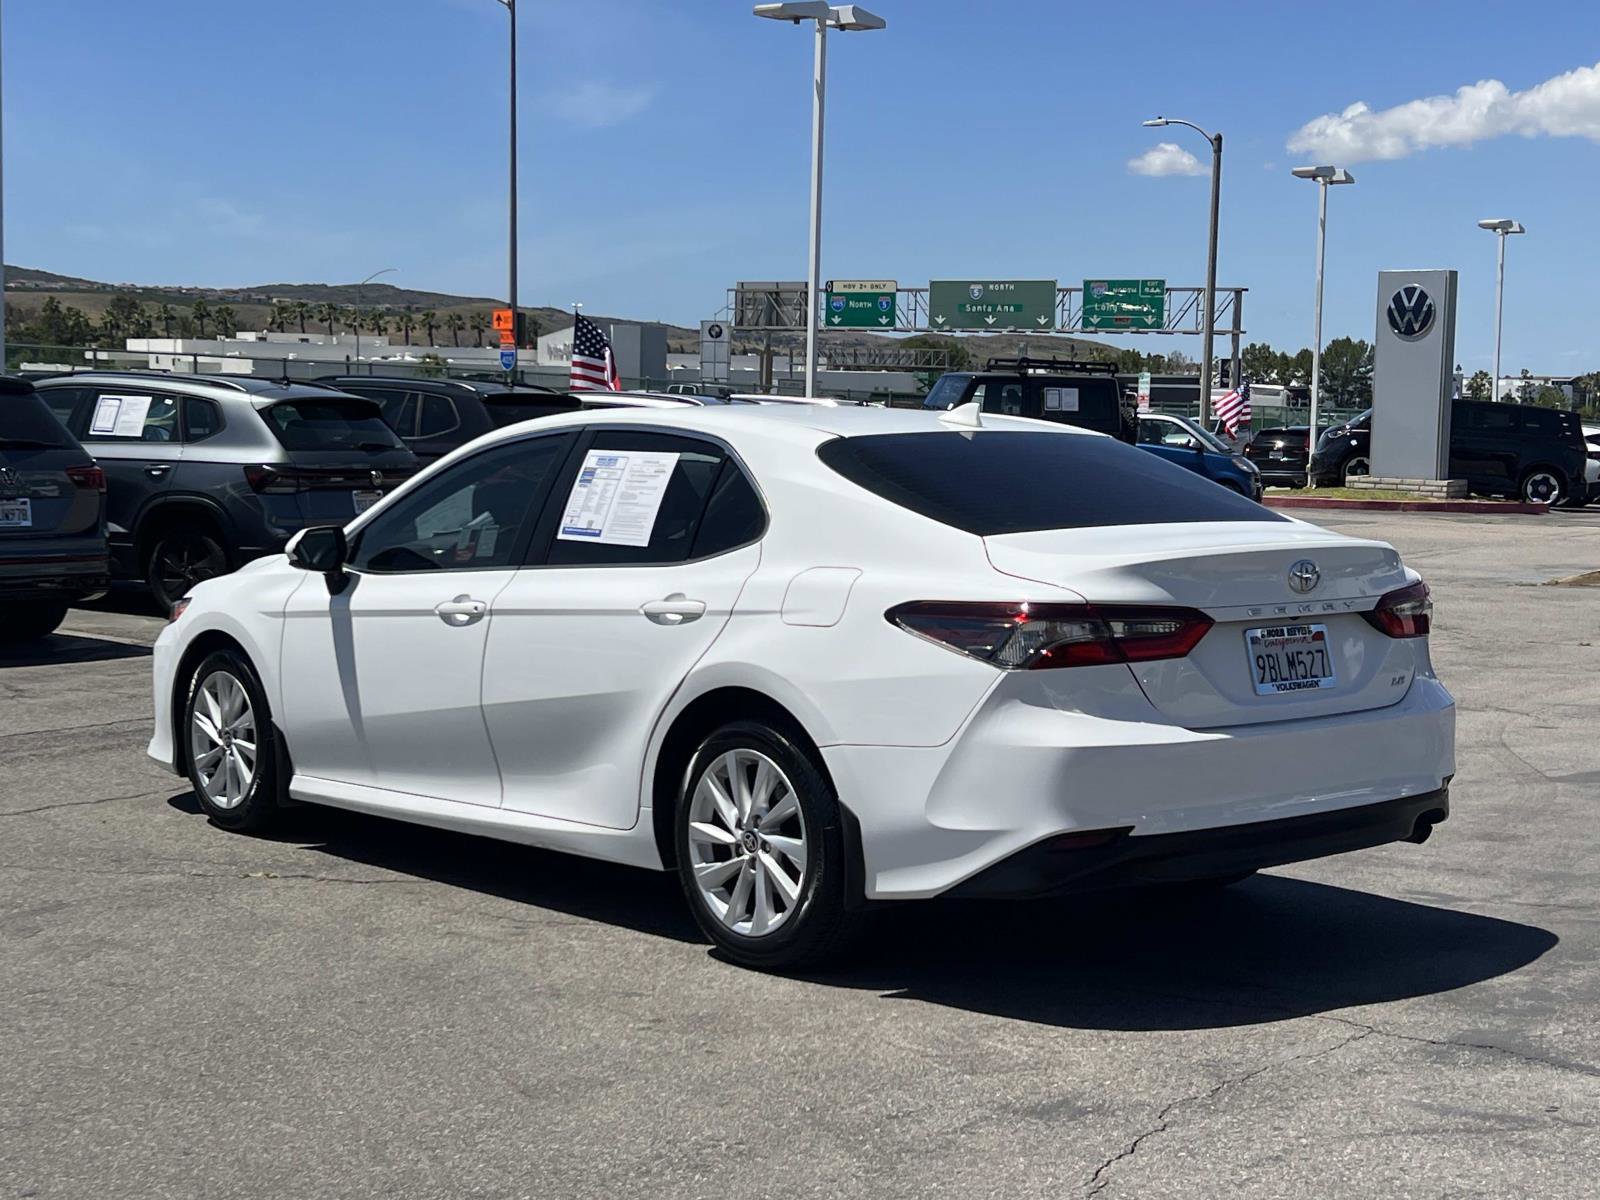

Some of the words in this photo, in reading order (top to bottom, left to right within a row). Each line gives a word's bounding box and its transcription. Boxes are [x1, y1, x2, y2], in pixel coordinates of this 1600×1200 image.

[965, 303, 992, 312] Santa
[996, 304, 1015, 312] Ana
[1256, 649, 1327, 684] 9BLM527
